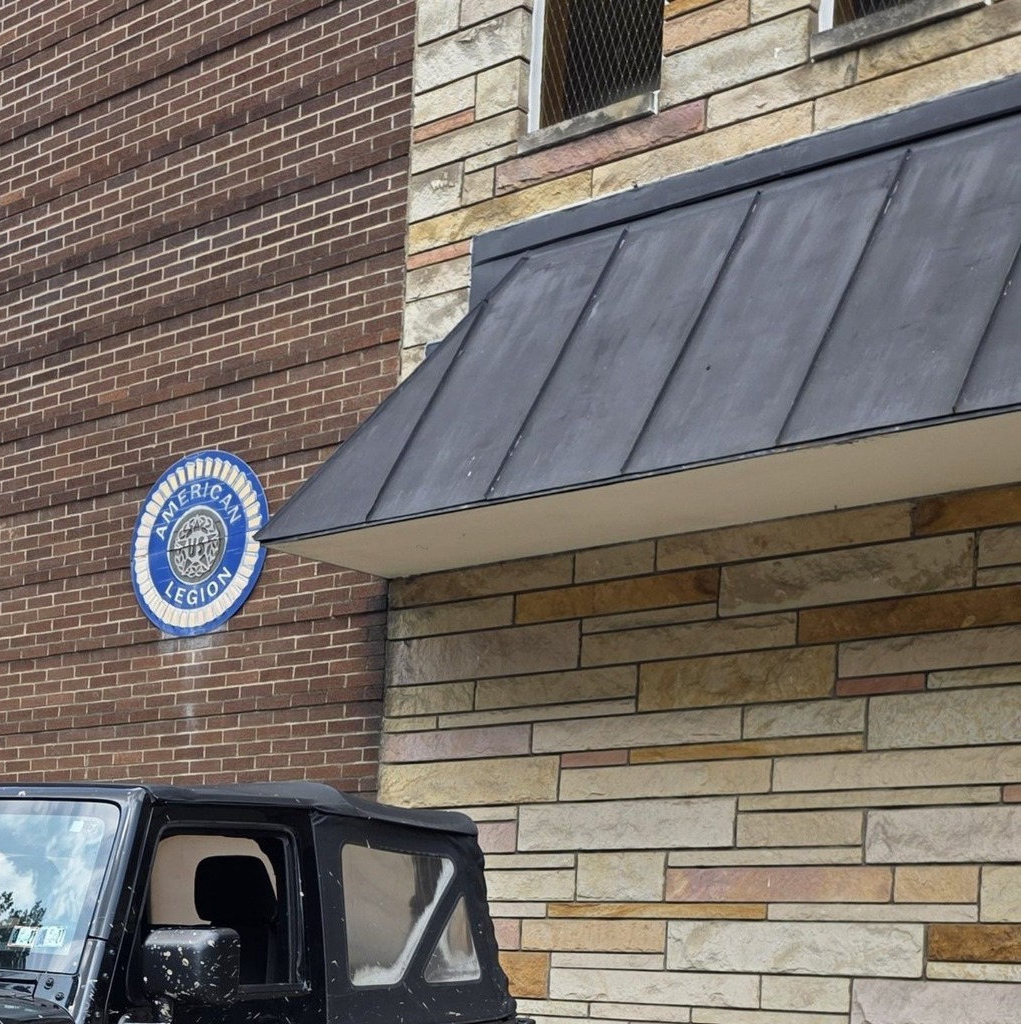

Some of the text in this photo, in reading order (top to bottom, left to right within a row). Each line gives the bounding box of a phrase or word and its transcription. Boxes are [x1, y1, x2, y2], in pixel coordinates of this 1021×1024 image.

[156, 482, 242, 541] AMERICAN
[188, 536, 205, 558] US
[165, 566, 232, 606] LEGION
